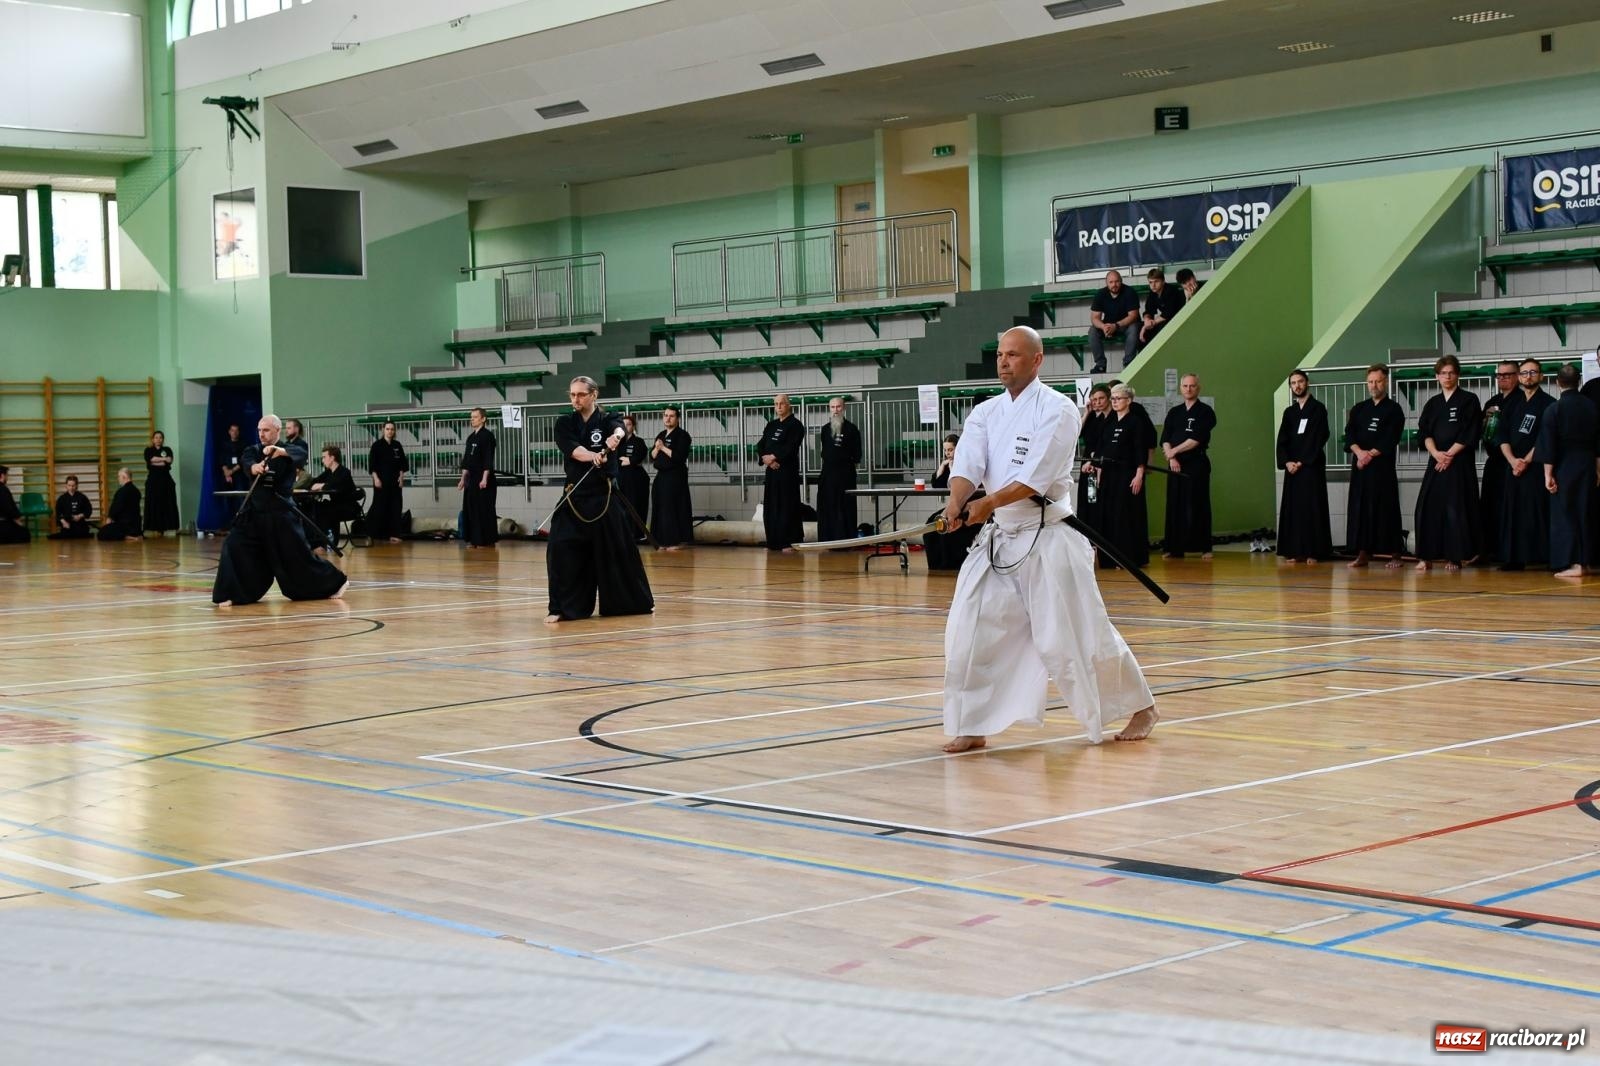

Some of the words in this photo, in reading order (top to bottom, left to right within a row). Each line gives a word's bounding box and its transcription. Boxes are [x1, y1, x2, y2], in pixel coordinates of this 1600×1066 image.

[1164, 114, 1180, 128] E
[1206, 202, 1271, 233] OSiR
[1078, 217, 1175, 248] RACIBÓRZ
[1078, 387, 1089, 405] Y
[512, 407, 521, 421] Z
